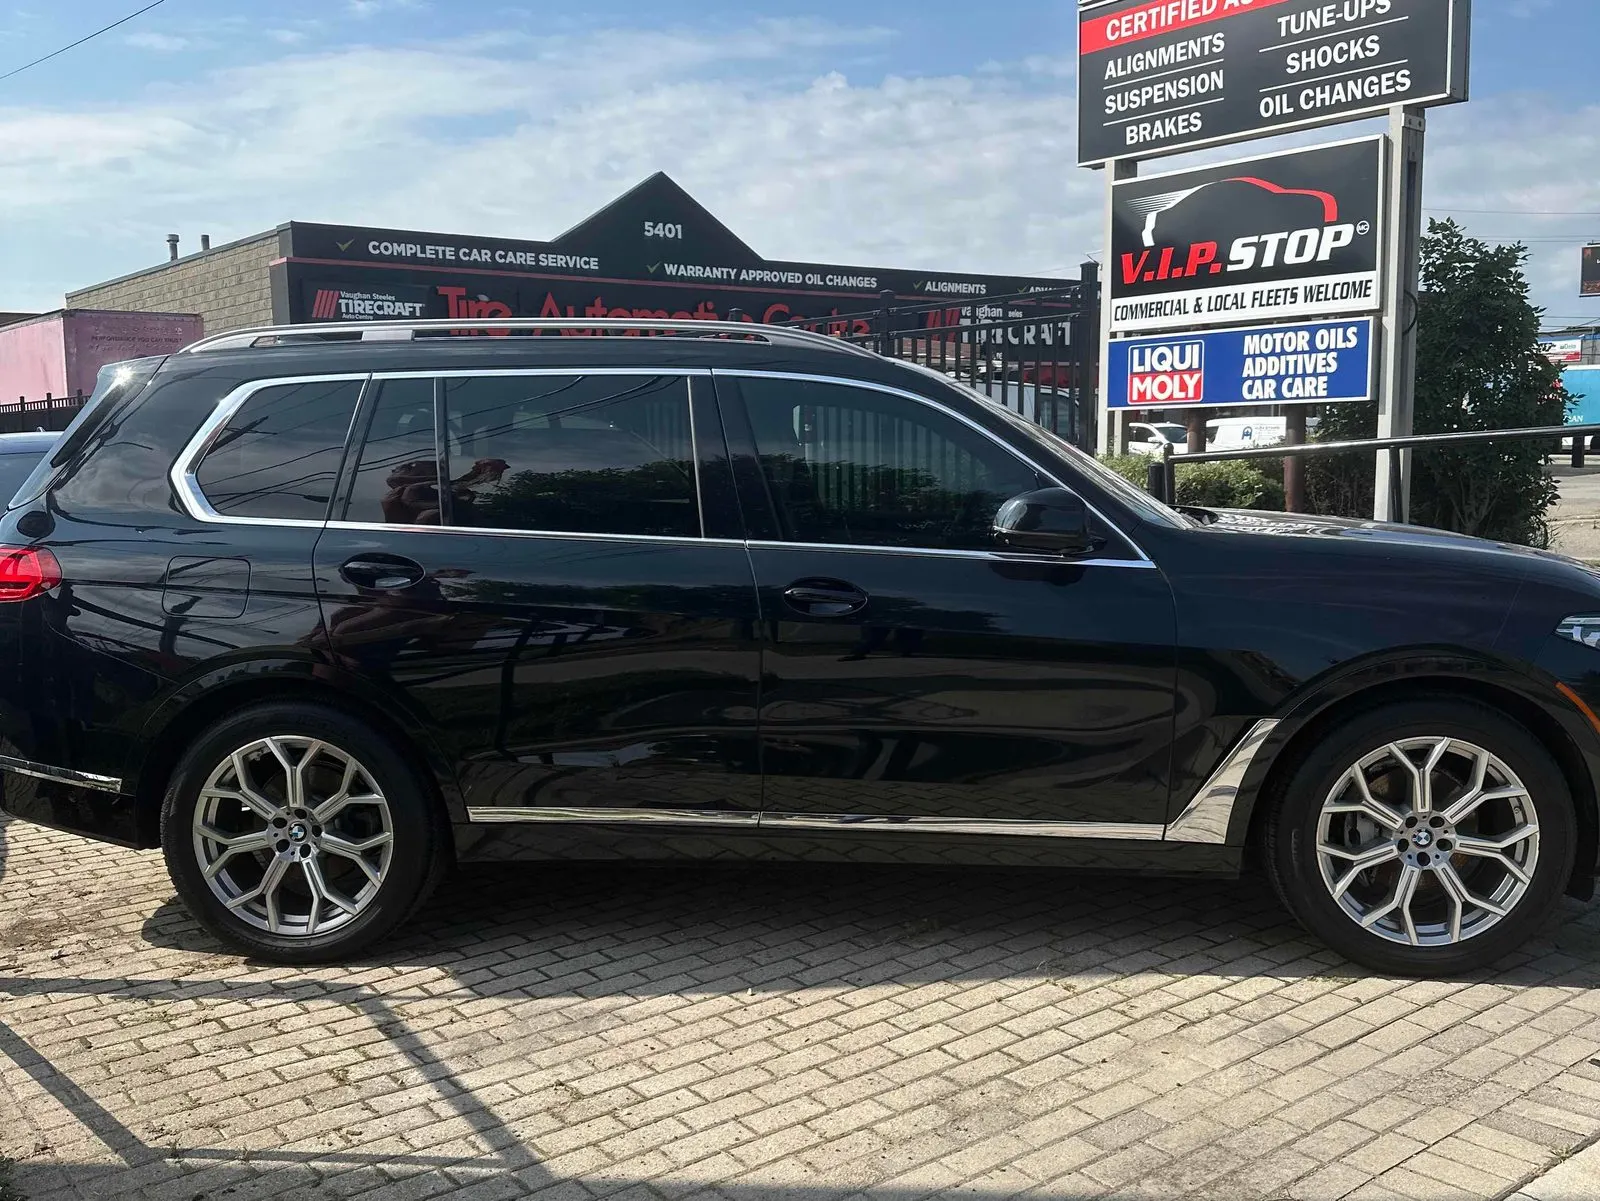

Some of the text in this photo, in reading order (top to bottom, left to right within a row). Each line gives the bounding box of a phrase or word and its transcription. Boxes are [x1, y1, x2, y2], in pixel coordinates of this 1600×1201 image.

[1106, 0, 1216, 41] CERTIFIED
[1277, 0, 1392, 37] TUNE-UPS
[1104, 32, 1225, 80] ALIGNMENTS
[1285, 34, 1381, 74] SHOCKS
[1104, 69, 1224, 114] SUSPENSION
[1259, 69, 1411, 118] OIL CHANGES
[1126, 112, 1202, 145] BRAKES
[644, 222, 683, 239] 5401
[368, 241, 599, 269] COMPLETE CAR CARE SERVICE
[664, 264, 877, 288] WARRANTY APPROVED OIL CHANGES
[925, 281, 987, 294] ALIGNMENTS
[338, 299, 422, 317] TIRECRAFT
[340, 291, 396, 301] Vaughan Steeles
[1114, 279, 1373, 322] COMMERCIAL & LOCAL FLEETS WELCOME
[1243, 326, 1358, 355] MOTOR OILS
[1132, 344, 1200, 373] LIQUI
[1242, 351, 1338, 377] ADDITIVES
[1131, 373, 1202, 400] MOLY
[1242, 376, 1328, 400] CAR CARE
